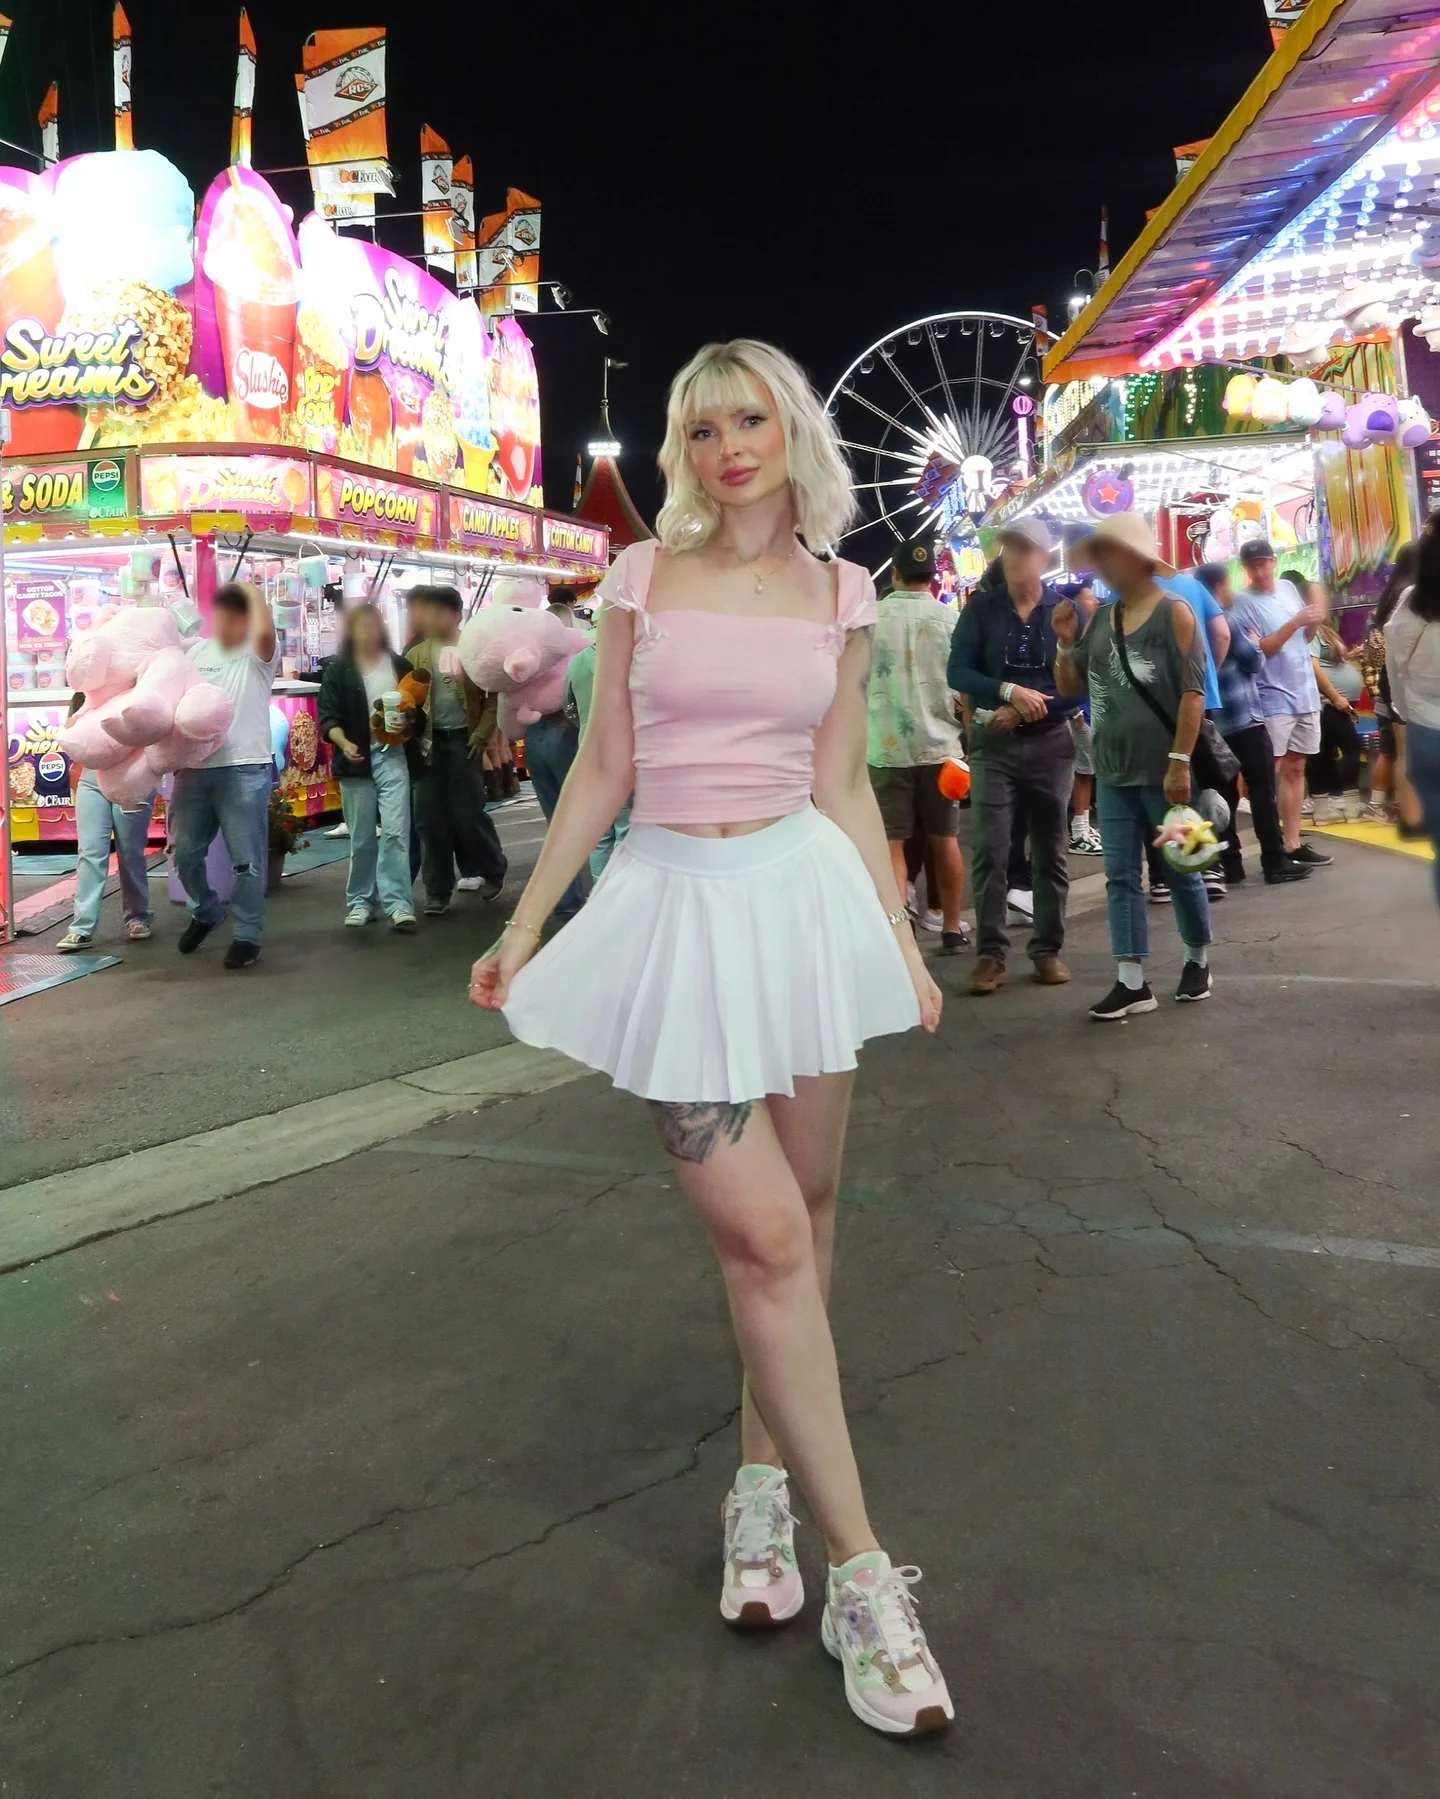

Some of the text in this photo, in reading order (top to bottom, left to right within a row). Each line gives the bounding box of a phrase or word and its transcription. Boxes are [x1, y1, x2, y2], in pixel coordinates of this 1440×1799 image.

[348, 83, 371, 95] RCS
[1, 319, 141, 371] Sweet
[0, 364, 156, 402] reams
[236, 350, 287, 401] Slushie
[20, 472, 83, 510] SODA
[94, 472, 119, 480] PEPSI
[339, 478, 419, 524] POPCORN
[463, 505, 520, 543] CANDY APPLES
[551, 526, 595, 556] COTTON CANDY
[16, 592, 41, 600] CANDY
[26, 585, 54, 593] COTTON
